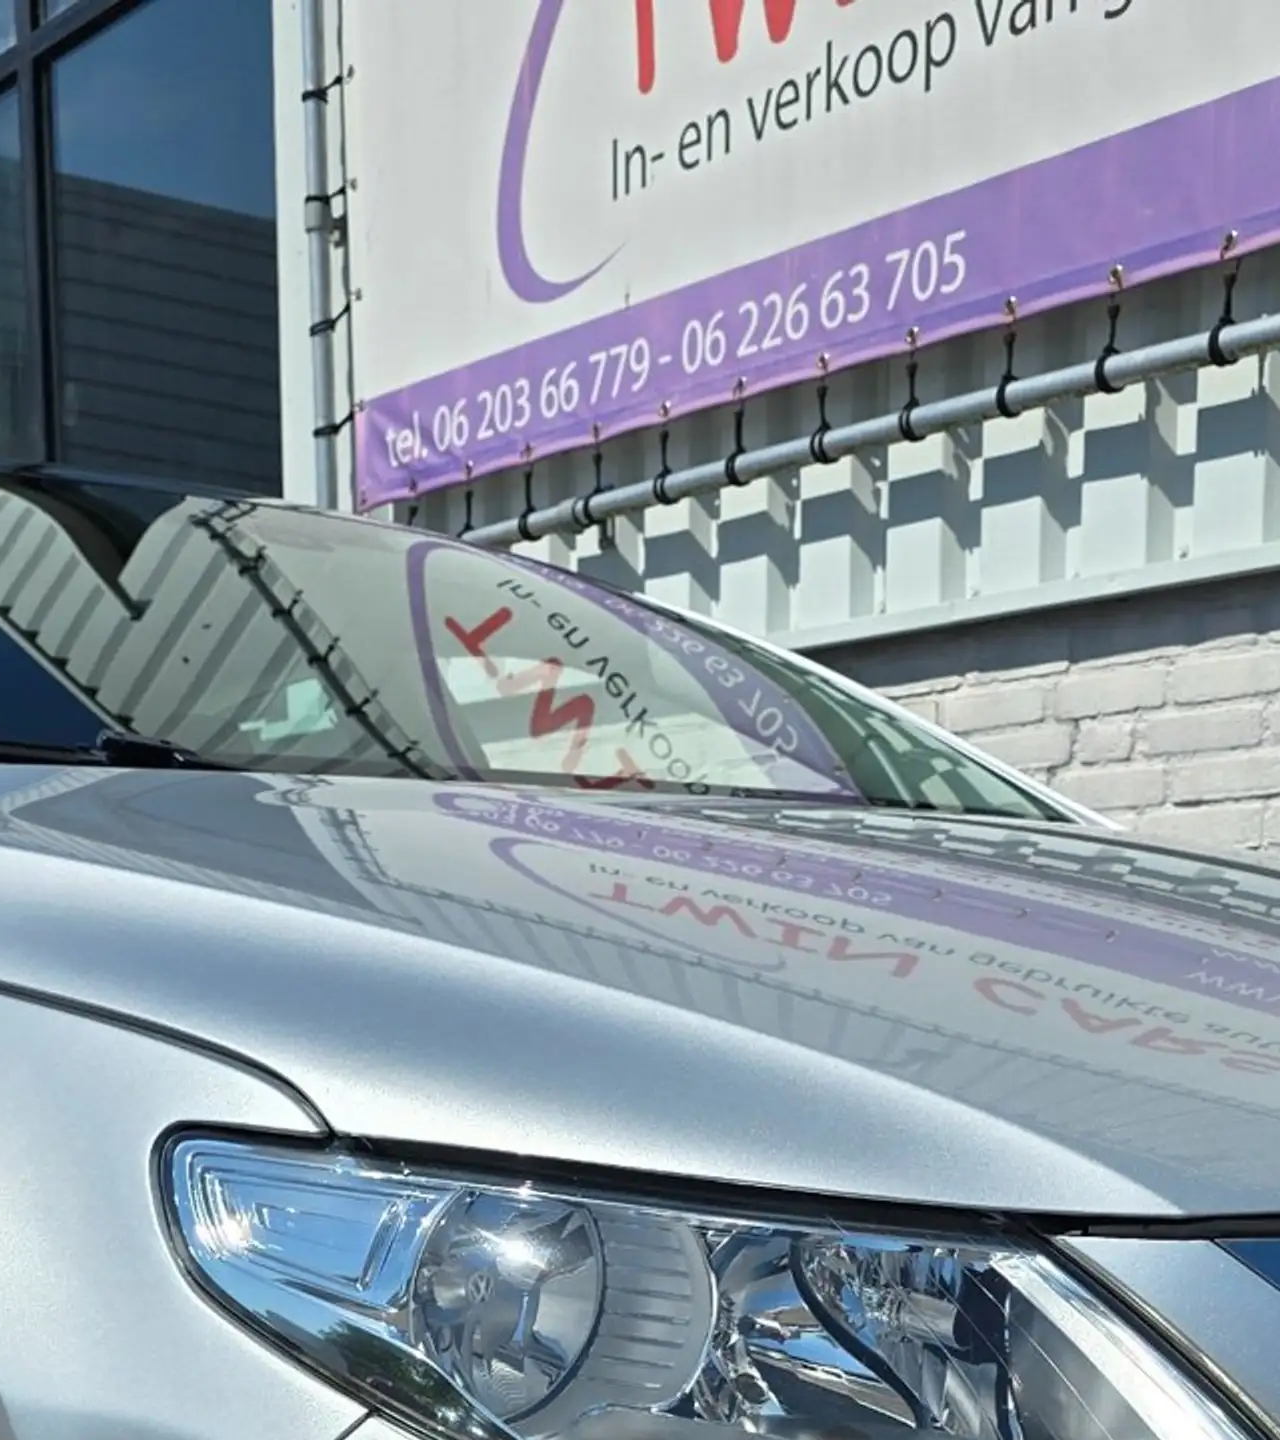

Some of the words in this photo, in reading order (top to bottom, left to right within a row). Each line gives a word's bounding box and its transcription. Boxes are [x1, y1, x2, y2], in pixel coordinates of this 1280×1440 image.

[611, 138, 667, 201] In-
[677, 108, 732, 170] en
[746, 12, 957, 141] verkoop
[384, 412, 429, 469] tel.
[433, 403, 469, 453] 06
[476, 380, 531, 440] 203
[539, 367, 580, 426] 66
[589, 338, 652, 405] 779
[682, 319, 727, 375] 06
[737, 284, 809, 358] 226
[820, 262, 871, 329] 63
[885, 231, 968, 312] 705
